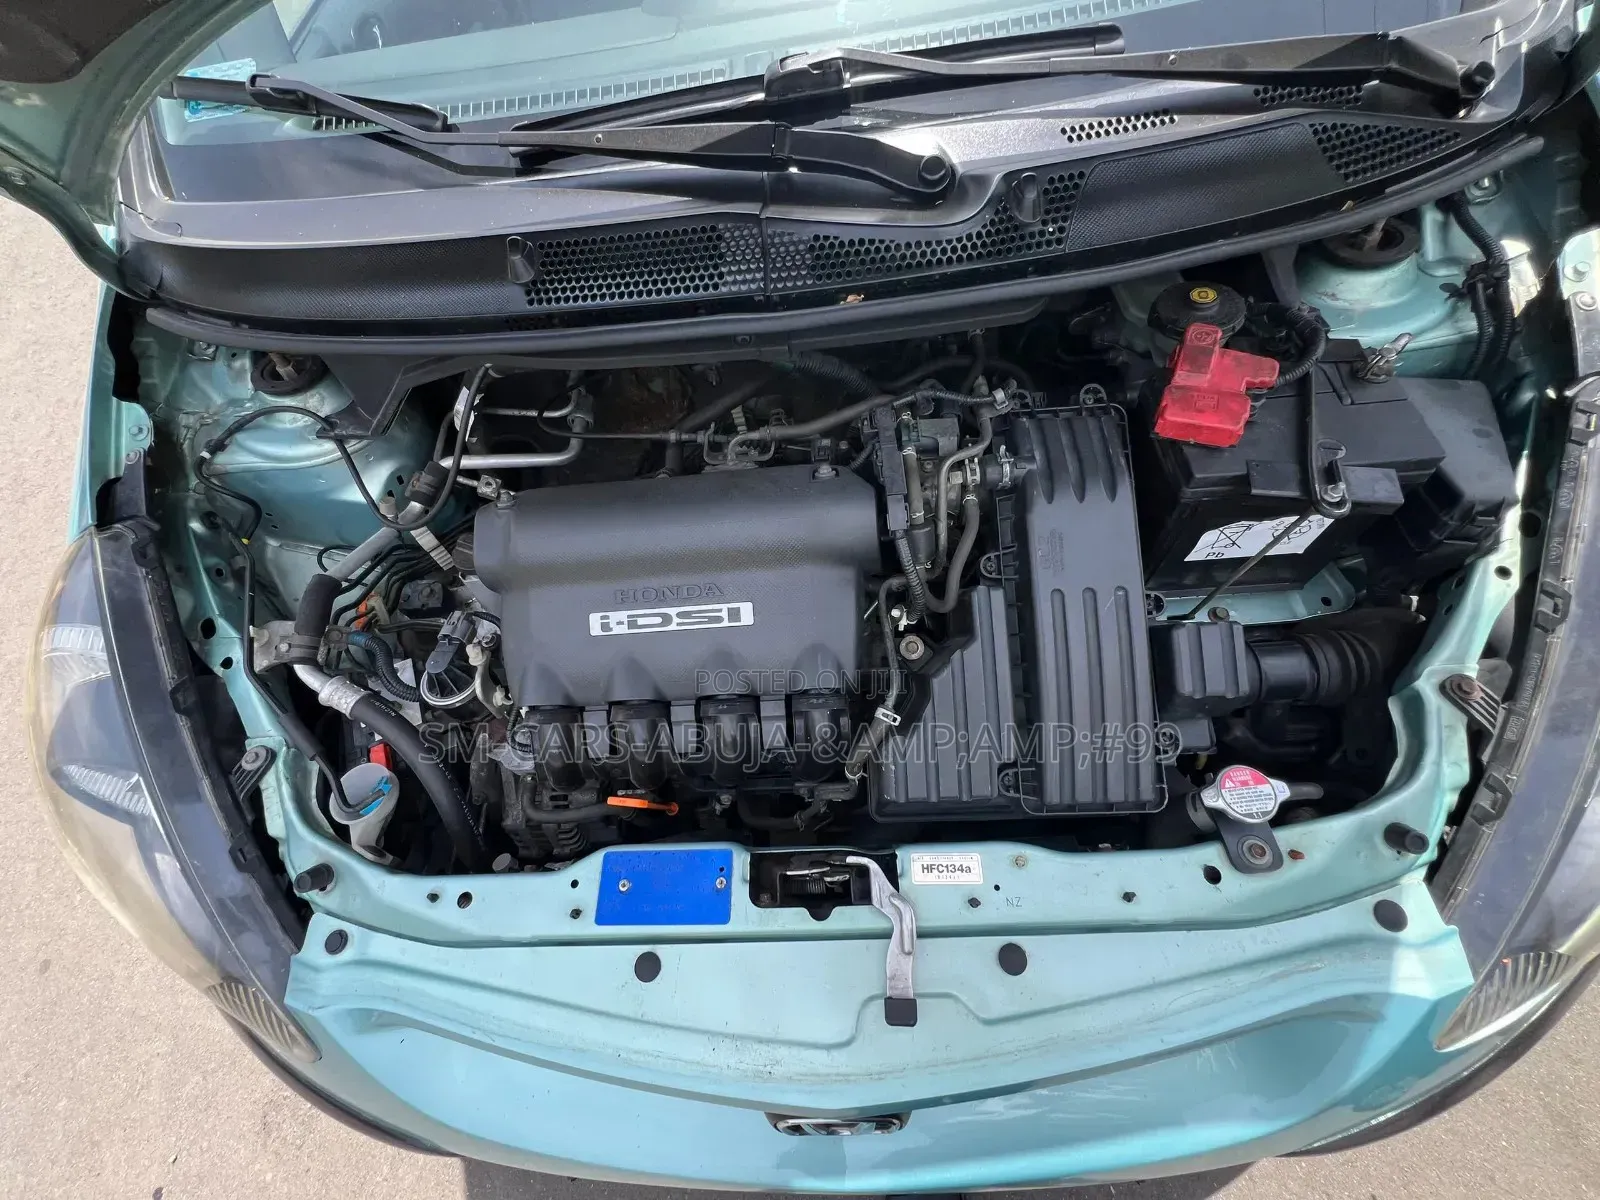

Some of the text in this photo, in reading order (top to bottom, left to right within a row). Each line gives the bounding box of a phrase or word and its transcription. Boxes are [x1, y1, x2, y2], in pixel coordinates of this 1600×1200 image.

[1205, 551, 1225, 559] Pb
[614, 582, 724, 605] HONDA
[600, 606, 742, 633] i-DSI
[921, 863, 972, 874] HFC134a
[1006, 896, 1022, 907] NZ
